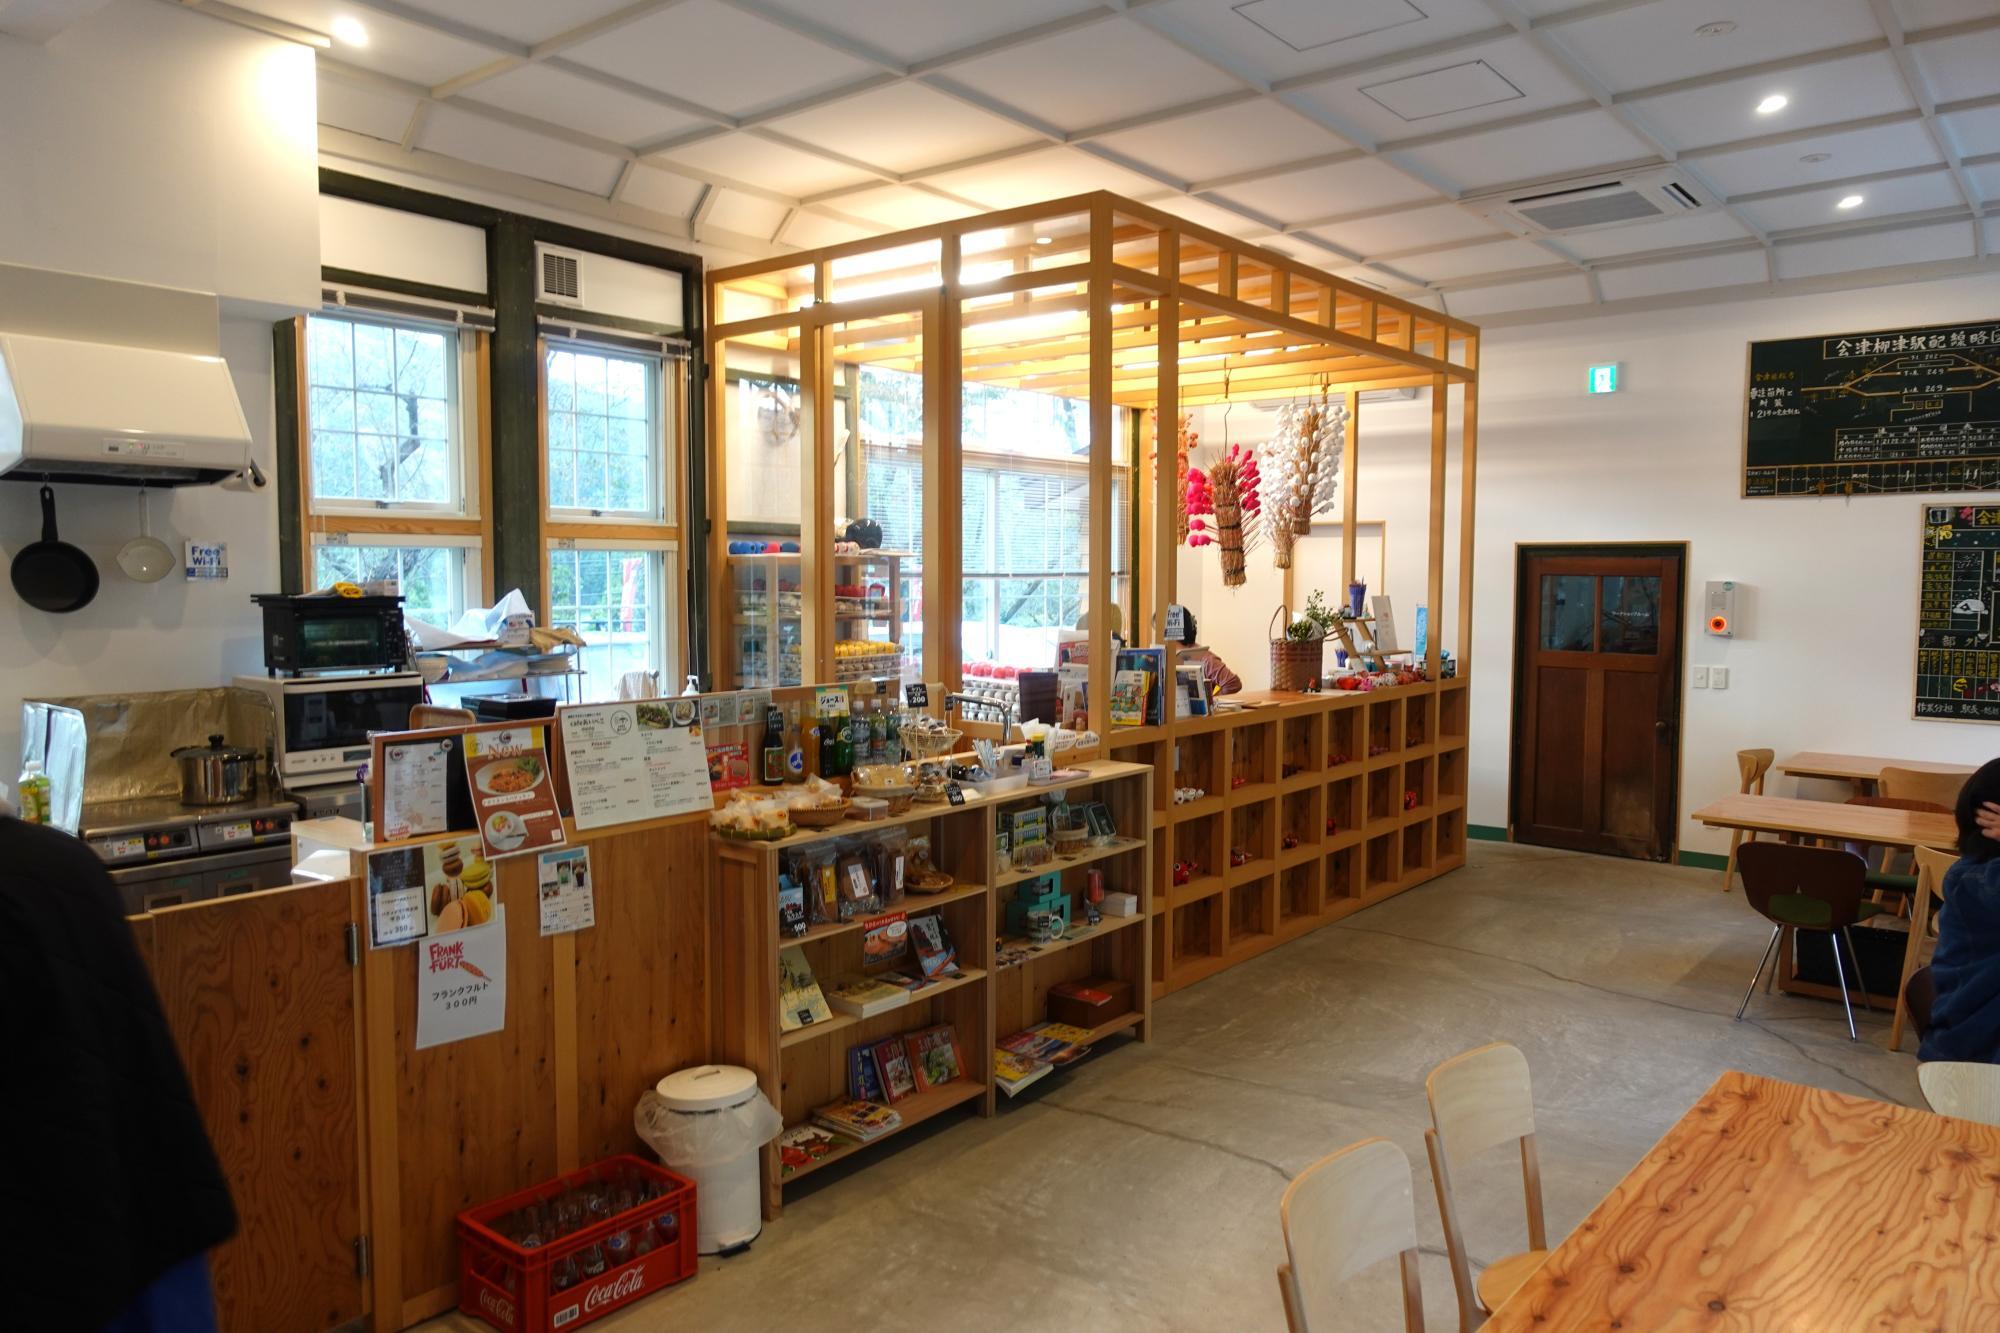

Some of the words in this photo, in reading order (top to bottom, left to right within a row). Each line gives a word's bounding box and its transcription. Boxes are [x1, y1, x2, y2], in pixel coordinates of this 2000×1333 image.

[191, 545, 220, 556] Free
[432, 981, 489, 1002] フランクフルト
[445, 995, 478, 1011] 300円
[584, 1264, 645, 1313] Coca-Cola
